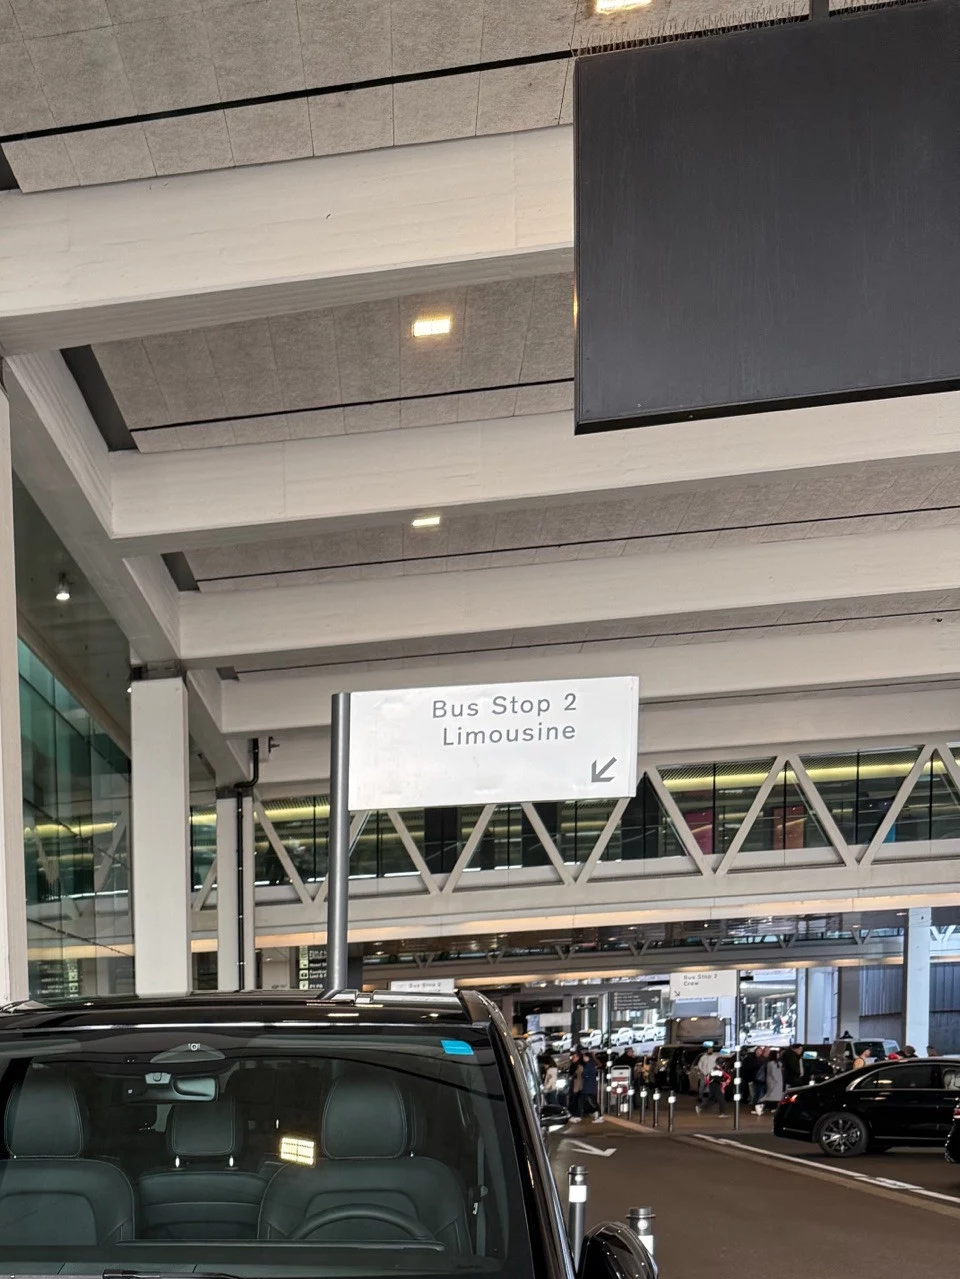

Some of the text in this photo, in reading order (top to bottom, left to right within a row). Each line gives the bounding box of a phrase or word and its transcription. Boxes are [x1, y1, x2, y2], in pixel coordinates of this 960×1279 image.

[432, 692, 577, 719] Bus Stop 2
[442, 722, 576, 746] Limousine
